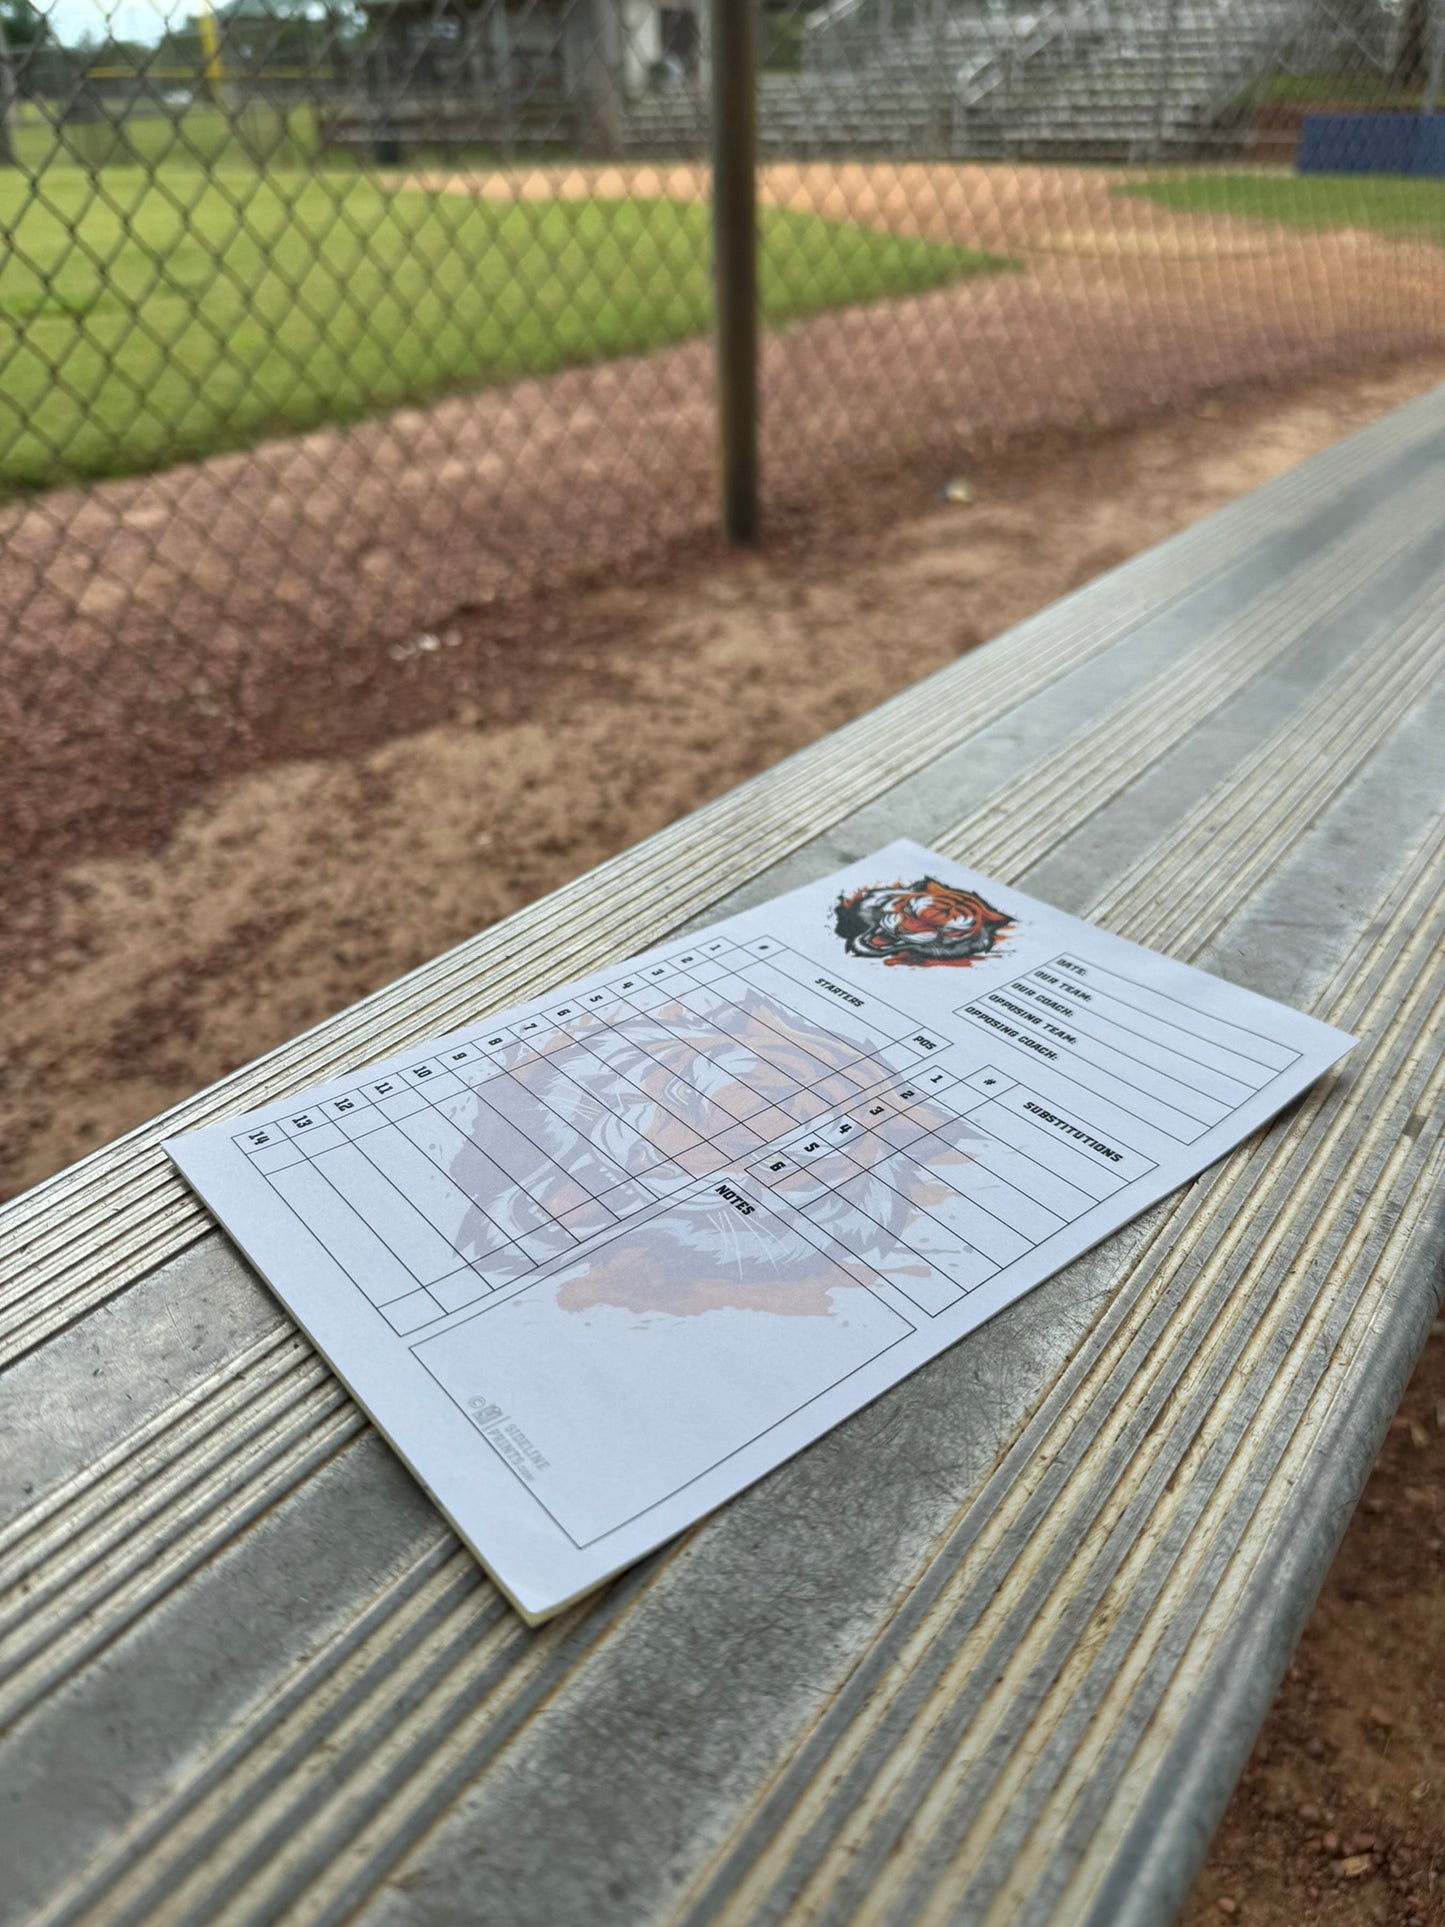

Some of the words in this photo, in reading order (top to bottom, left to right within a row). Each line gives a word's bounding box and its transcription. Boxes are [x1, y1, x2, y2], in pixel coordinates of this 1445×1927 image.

[681, 956, 694, 964] 2
[651, 968, 665, 976] 3
[1056, 958, 1087, 976] DATE:
[622, 981, 634, 989] 4
[1033, 970, 1059, 984] OUR
[1059, 982, 1092, 1002] TEAM:
[589, 994, 603, 1003] 5
[814, 977, 865, 1008] STARTERS
[1011, 982, 1036, 996] OUR
[1035, 994, 1074, 1018] COACH:
[556, 1008, 571, 1017] 6
[988, 994, 1043, 1025] OPPOSING
[1042, 1023, 1077, 1045] TEAM:
[523, 1022, 538, 1031] 7
[964, 1006, 1019, 1038] OPPOSING
[1018, 1035, 1058, 1061] COACH:
[488, 1037, 503, 1046] 8
[912, 1035, 937, 1050] POS
[452, 1052, 468, 1061] 9
[412, 1065, 433, 1078] 10
[930, 1074, 943, 1084] 1
[983, 1078, 997, 1086] #
[374, 1082, 394, 1095] 11
[899, 1090, 915, 1100] 2
[333, 1098, 355, 1112] 12
[869, 1105, 885, 1116] 3
[291, 1115, 314, 1129] 13
[839, 1123, 853, 1134] 4
[1022, 1101, 1124, 1162] SUBSTITUTIONS
[248, 1130, 271, 1146] 14
[804, 1141, 820, 1153] 5
[769, 1161, 787, 1172] 6
[715, 1184, 756, 1216] NOTES
[504, 1423, 551, 1471] SIDELINE
